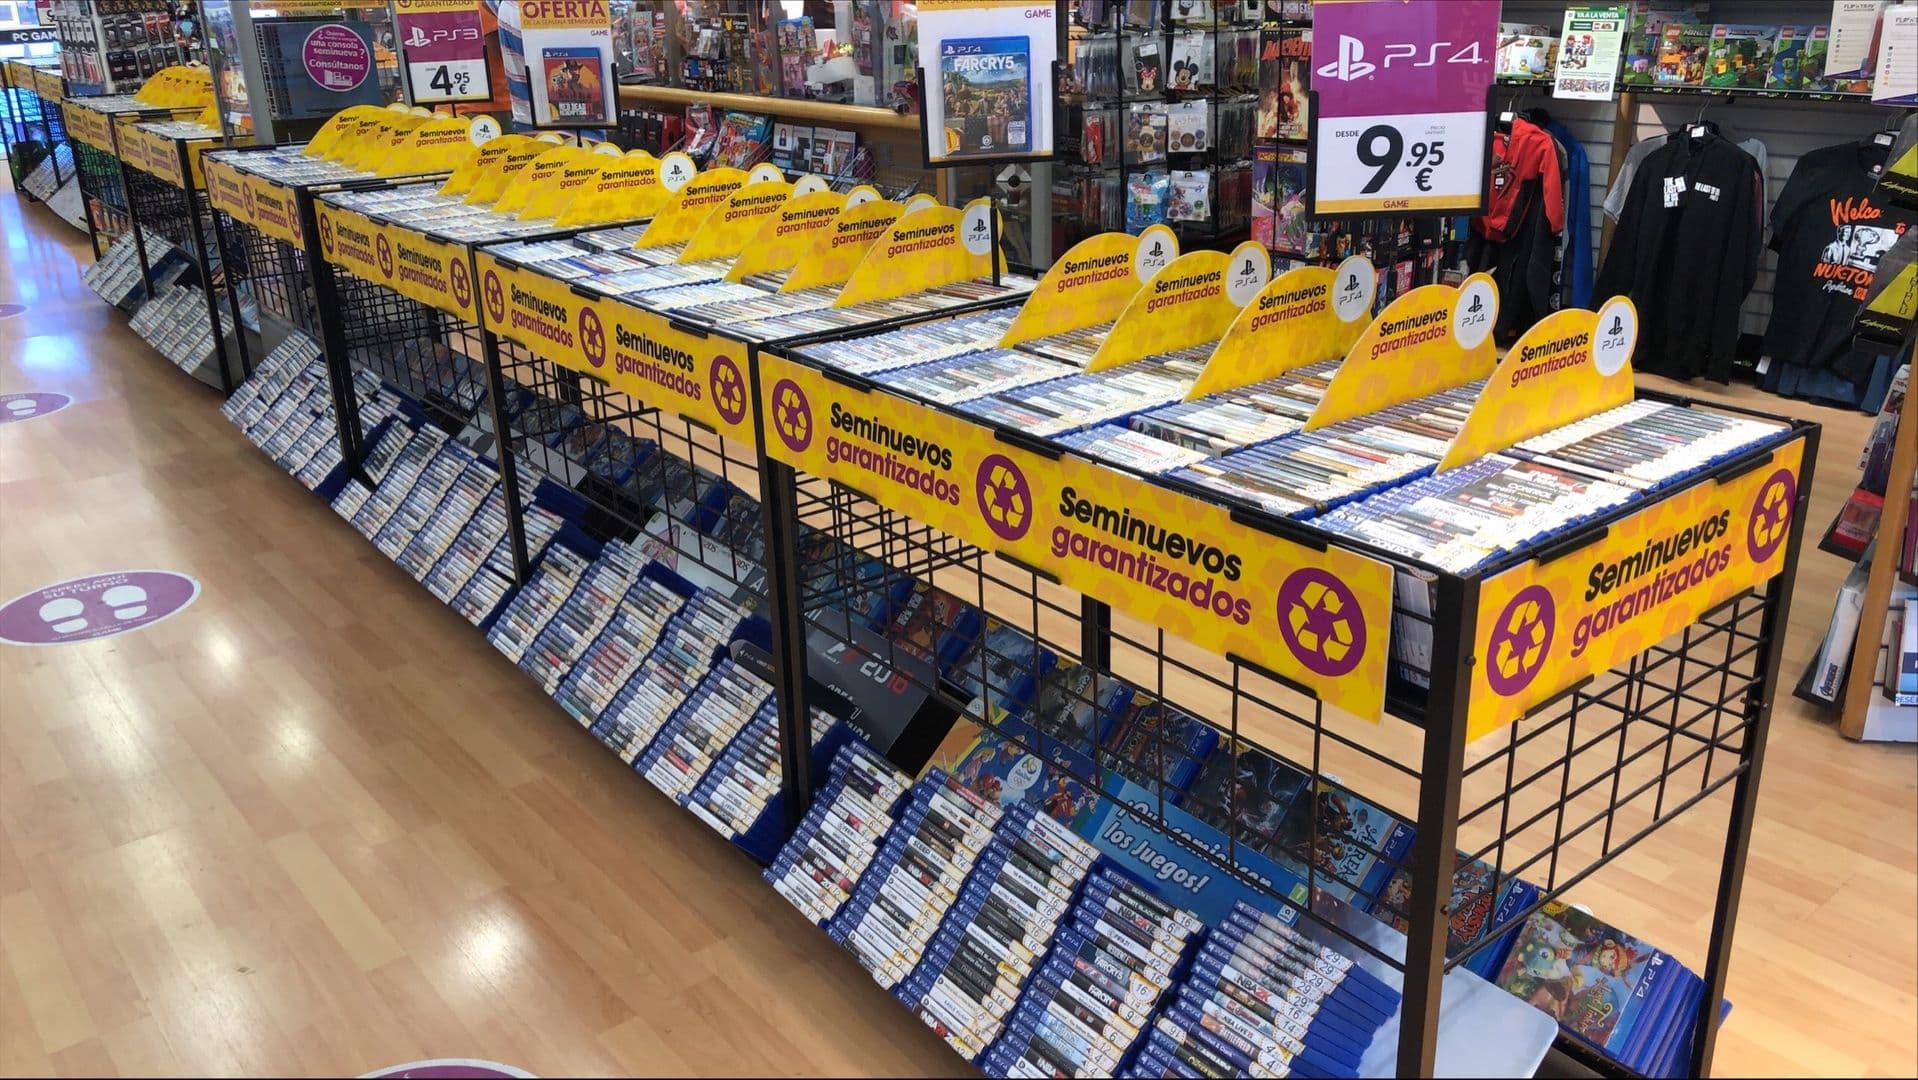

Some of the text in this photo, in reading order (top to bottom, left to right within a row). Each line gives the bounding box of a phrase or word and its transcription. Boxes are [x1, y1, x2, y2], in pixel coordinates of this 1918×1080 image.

[523, 0, 606, 19] OFERTA
[1025, 9, 1052, 19] GAME
[12, 33, 29, 42] PC
[327, 40, 359, 49] consola
[433, 28, 479, 42] PS3
[590, 29, 608, 37] GAME
[314, 48, 358, 56] seminueva
[1384, 41, 1482, 68] PS4
[308, 58, 364, 70] Consúltanos
[416, 136, 466, 148] garantizados
[420, 128, 466, 138] Seminuevos
[1336, 130, 1360, 138] DESDE
[597, 177, 656, 192] garantizados
[602, 166, 655, 180] Seminuevos
[1414, 167, 1434, 192] €
[686, 180, 742, 196] Seminuevos
[730, 192, 787, 208] Seminuevos
[1383, 200, 1409, 208] GAME
[1830, 196, 1884, 227] Welco
[724, 204, 782, 222] garantizad
[782, 206, 840, 222] Seminuevos
[837, 216, 897, 233] Seminuevos
[336, 220, 370, 248] Seminuevos
[776, 218, 833, 236] garantizad
[893, 223, 955, 242] Seminuevos
[337, 241, 376, 266] garantizados
[396, 242, 442, 274] Seminuevos
[888, 235, 956, 258] garantizados
[1064, 252, 1129, 274] Seminuevos
[1143, 258, 1166, 266] PS4
[398, 264, 448, 294] garantizados
[1058, 265, 1129, 292] garantizados
[1155, 270, 1221, 294] Seminuevos
[1234, 276, 1258, 288] PS4
[510, 283, 568, 324] Seminuevos
[1147, 284, 1220, 313] garantizados
[1258, 283, 1327, 310] Seminuevos
[1339, 291, 1362, 306] PS4
[1250, 298, 1326, 332] garantizados
[1379, 308, 1448, 338] Seminuevos
[1462, 313, 1486, 328] PS4
[510, 308, 574, 348] garantizados
[615, 324, 695, 373] Seminuevos
[1371, 324, 1448, 360] garantizados
[1520, 332, 1589, 363] Seminuevos
[1602, 336, 1626, 352] PS4
[614, 350, 702, 401] garantizados
[1510, 350, 1588, 388] garantizados
[830, 402, 952, 471] Seminuevos
[826, 434, 960, 506] garantizados
[1059, 486, 1243, 582] Seminuevos
[1584, 508, 1732, 603] Seminuevos
[72, 578, 129, 594] TURNO
[1050, 526, 1252, 626] garantizados
[1570, 543, 1733, 659] garantizados
[1103, 820, 1210, 895] los Juegos!
[1496, 895, 1515, 923] PS4
[1635, 967, 1655, 998] PS4
